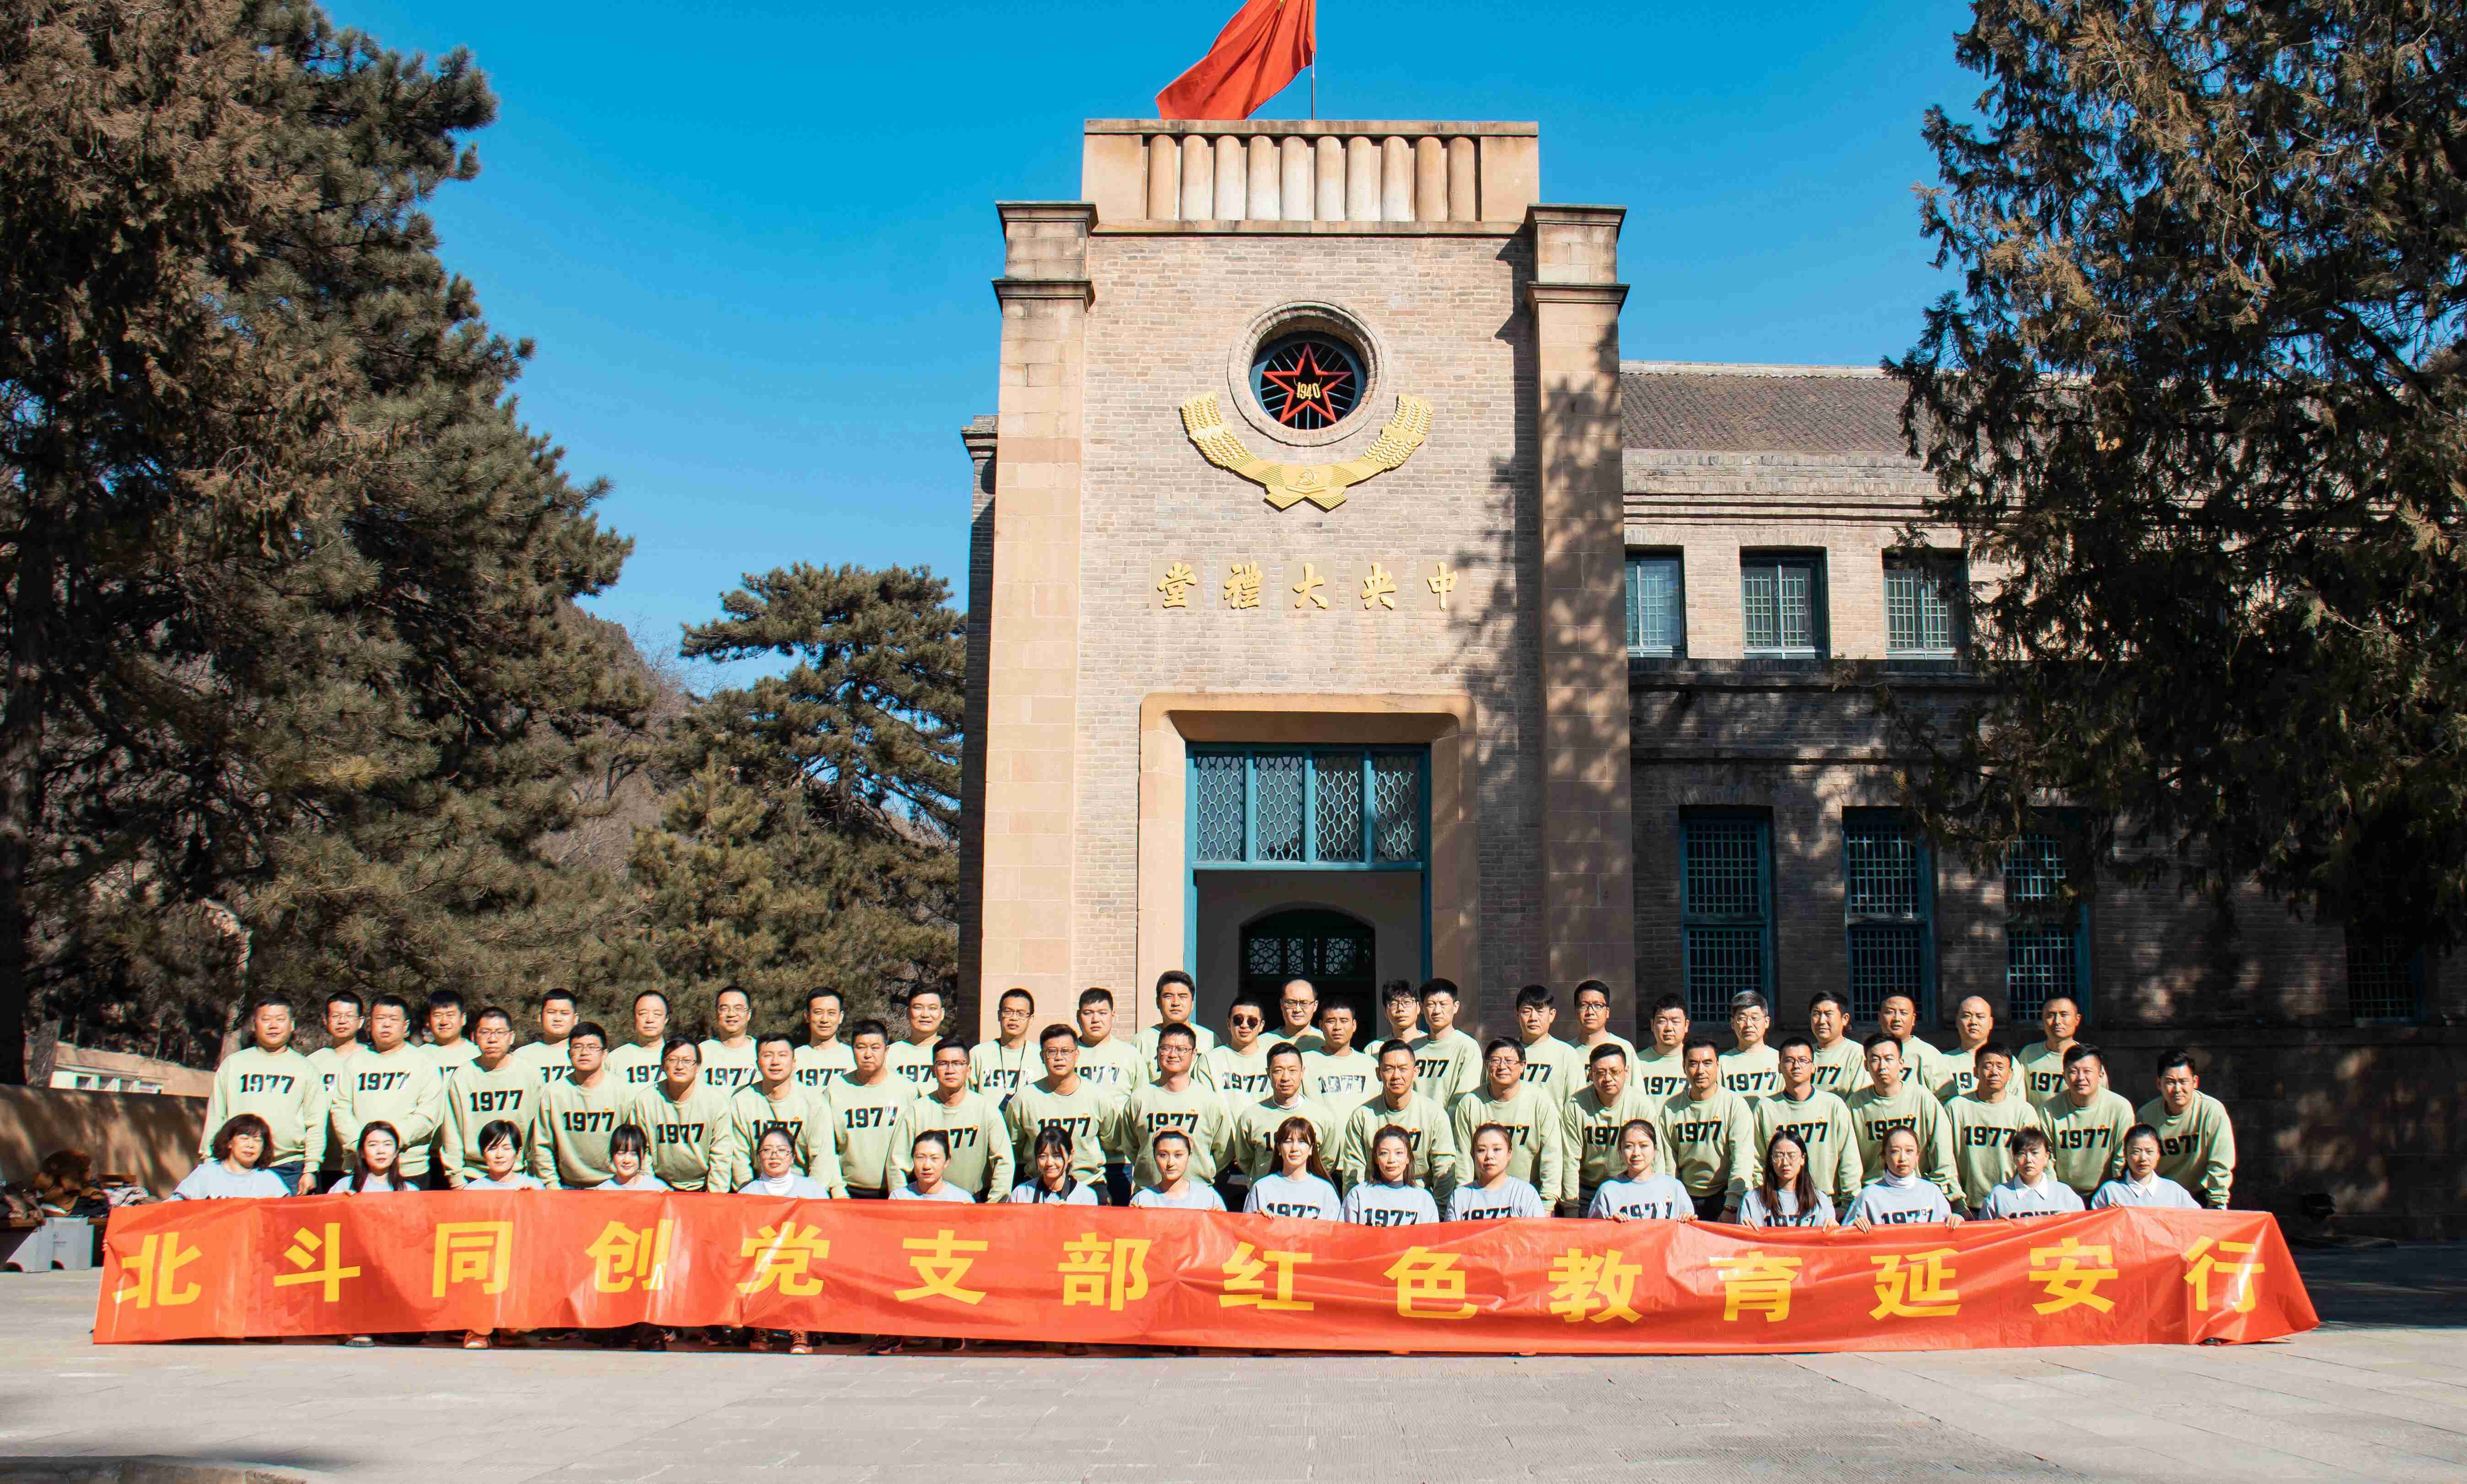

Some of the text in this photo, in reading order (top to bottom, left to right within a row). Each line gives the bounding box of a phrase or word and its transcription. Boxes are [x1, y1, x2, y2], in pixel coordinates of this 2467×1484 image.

[1296, 381, 1321, 400] 1940
[705, 1068, 756, 1086] 1977
[1416, 1059, 1449, 1078] 977
[1520, 1063, 1552, 1083] 77
[1810, 1065, 1841, 1085] 77
[241, 1073, 295, 1094] 1977
[358, 1071, 410, 1091] 1977
[1318, 1075, 1366, 1094] 1977
[1727, 1072, 1777, 1091] 1977
[2030, 1071, 2063, 1093] 197
[469, 1089, 523, 1112] 1977
[563, 1111, 614, 1132] 1977
[845, 1106, 898, 1129] 1977
[657, 1123, 705, 1143] 1977
[950, 1125, 978, 1149] 77
[1584, 1126, 1620, 1145] 197
[1675, 1120, 1722, 1142] 1977
[1963, 1126, 2017, 1148] 1977
[2060, 1127, 2111, 1149] 1977
[1363, 1208, 1418, 1227] 1977
[112, 1219, 2266, 1322] 北斗同创党支部红色教育延安行
